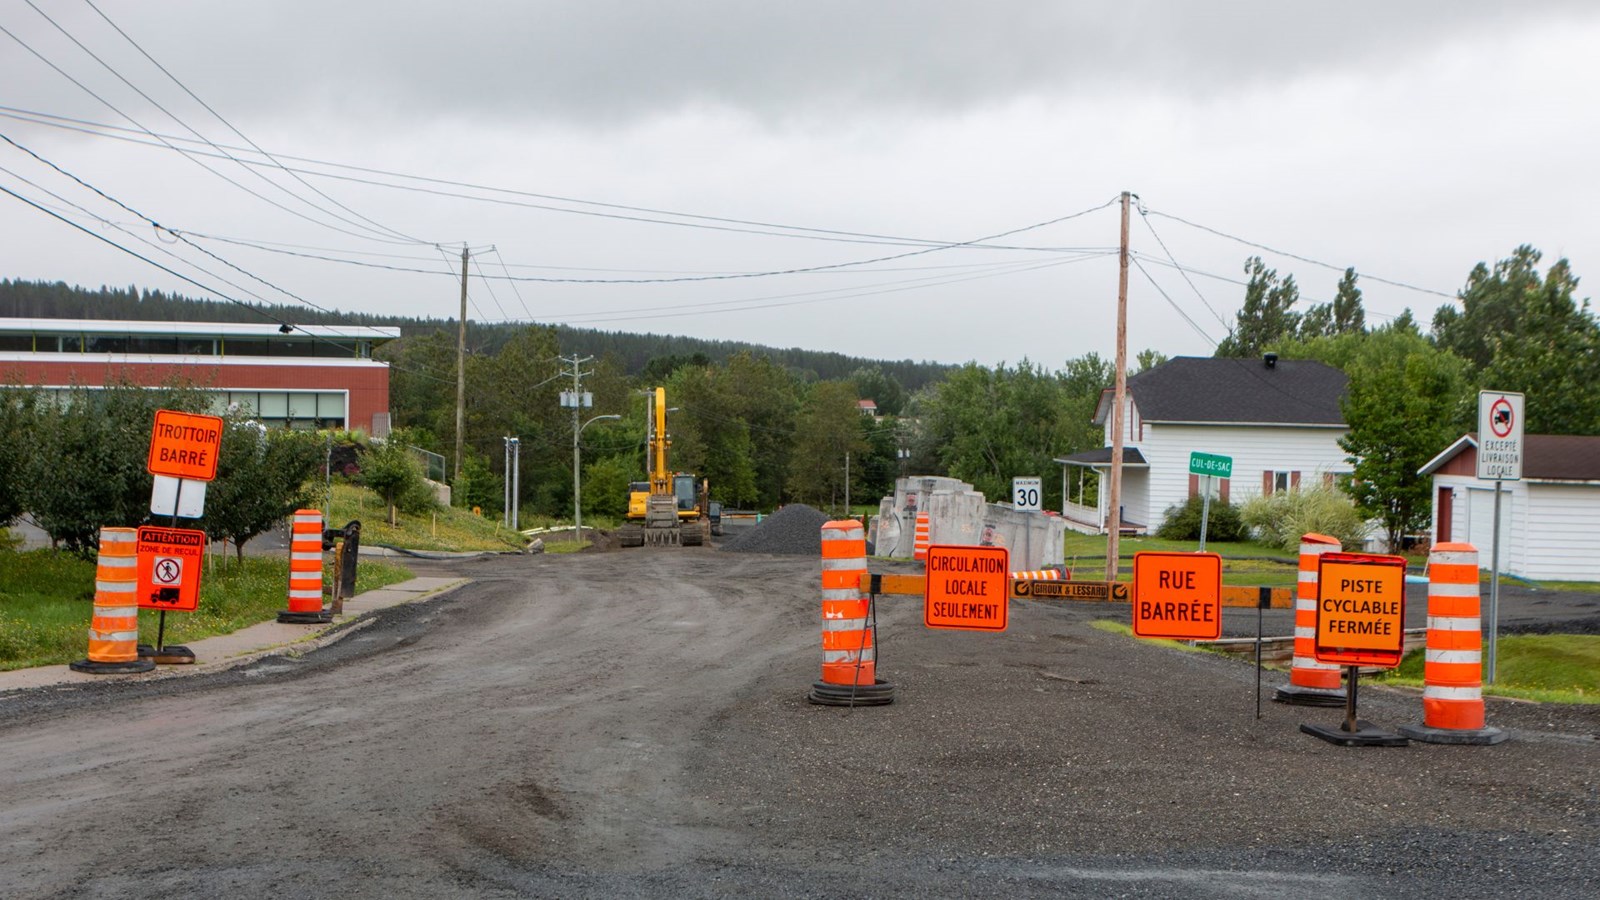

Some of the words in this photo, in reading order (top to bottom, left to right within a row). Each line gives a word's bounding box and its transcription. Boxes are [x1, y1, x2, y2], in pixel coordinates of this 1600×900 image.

[158, 423, 217, 444] TROTTOIR
[1485, 440, 1517, 452] EXCEPTÉ
[160, 447, 207, 467] BARRÉ
[1191, 457, 1231, 472] CUL-DE-SAC
[1481, 453, 1519, 464] LIVRAISON
[1487, 465, 1513, 476] LOCALE
[1017, 488, 1038, 507] 30
[144, 532, 198, 544] ATTENTION
[140, 545, 160, 553] ZONE
[162, 547, 171, 555] DE
[175, 548, 199, 556] RECUL
[931, 555, 1004, 574] CIRCULATION
[945, 579, 988, 596] LOCALE
[1159, 570, 1196, 590] RUE
[1341, 579, 1383, 594] PISTE
[1034, 583, 1063, 594] GIROUX
[1064, 585, 1071, 594] &
[1072, 585, 1108, 597] LESSARD
[933, 601, 999, 620] SEULEMENT
[1141, 599, 1214, 622] BARRÉE
[1322, 598, 1399, 615] CYCLABLE
[1329, 618, 1392, 635] FERMÉE
